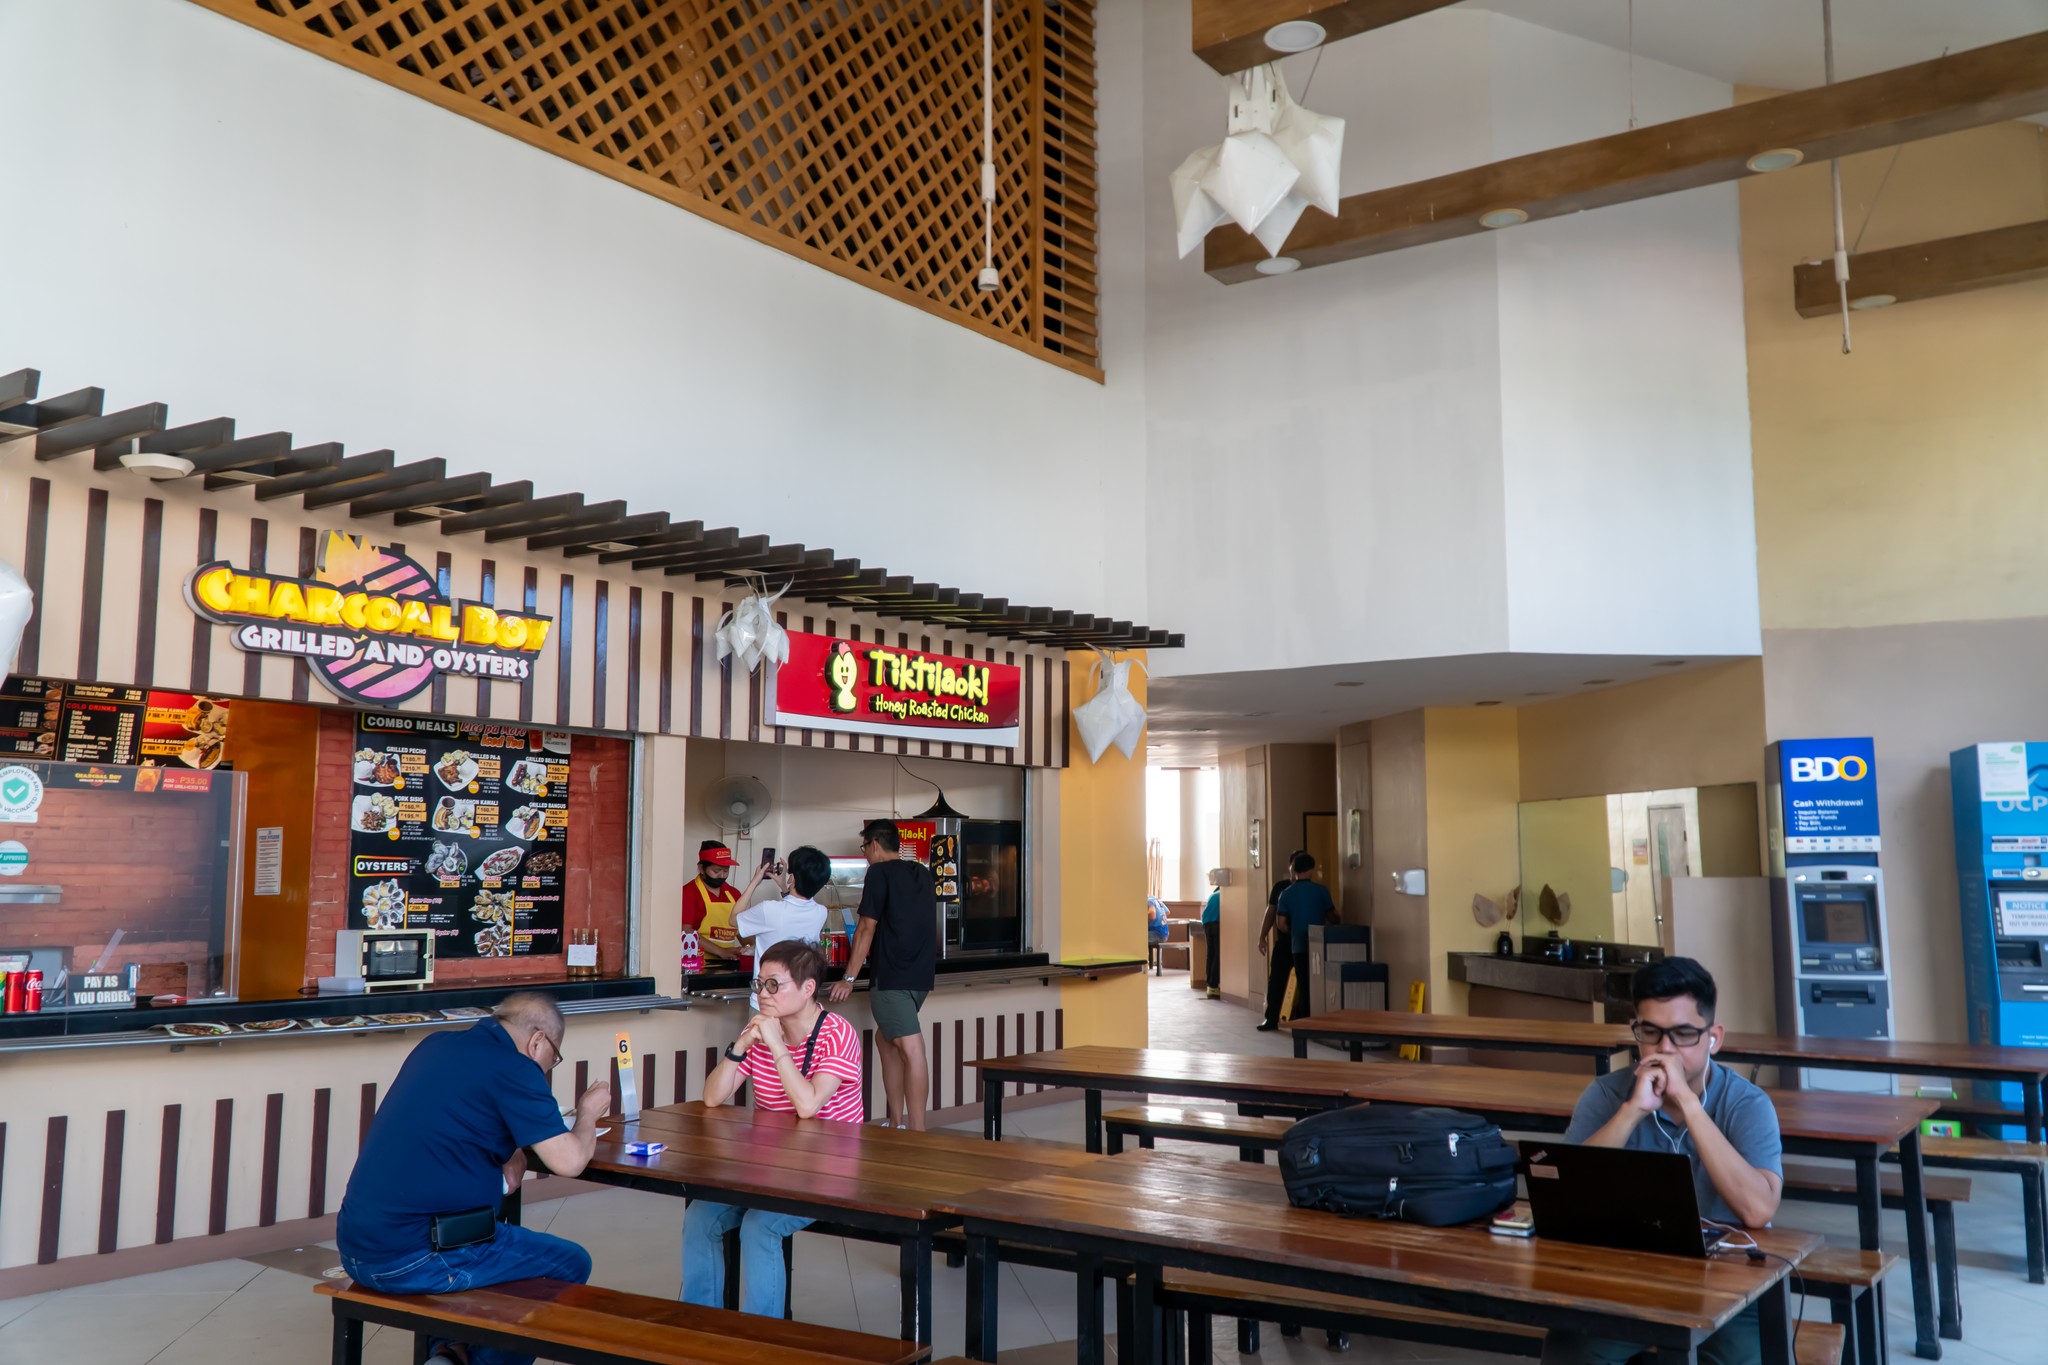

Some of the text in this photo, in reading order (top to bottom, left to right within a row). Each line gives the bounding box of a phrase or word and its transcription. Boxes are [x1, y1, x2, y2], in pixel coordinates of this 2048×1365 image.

[198, 567, 552, 651] CHARCOAL BOY
[240, 624, 529, 679] GRILLED AND OYSTERS
[870, 649, 990, 706] Tiktilaok!
[876, 694, 988, 724] Honey Roasted Chicken
[367, 716, 456, 732] COMBO MEALS
[461, 722, 526, 736] Rice pa More
[481, 736, 505, 748] Iced
[506, 736, 525, 749] Tea
[1790, 756, 1868, 782] BDO
[1816, 799, 1863, 807] Withdrawal
[357, 862, 408, 871] OYSTERS
[2012, 902, 2046, 911] NOTICE
[84, 975, 118, 988] PAY AS
[74, 990, 131, 1005] YOU ORDER
[619, 1039, 628, 1053] 6
